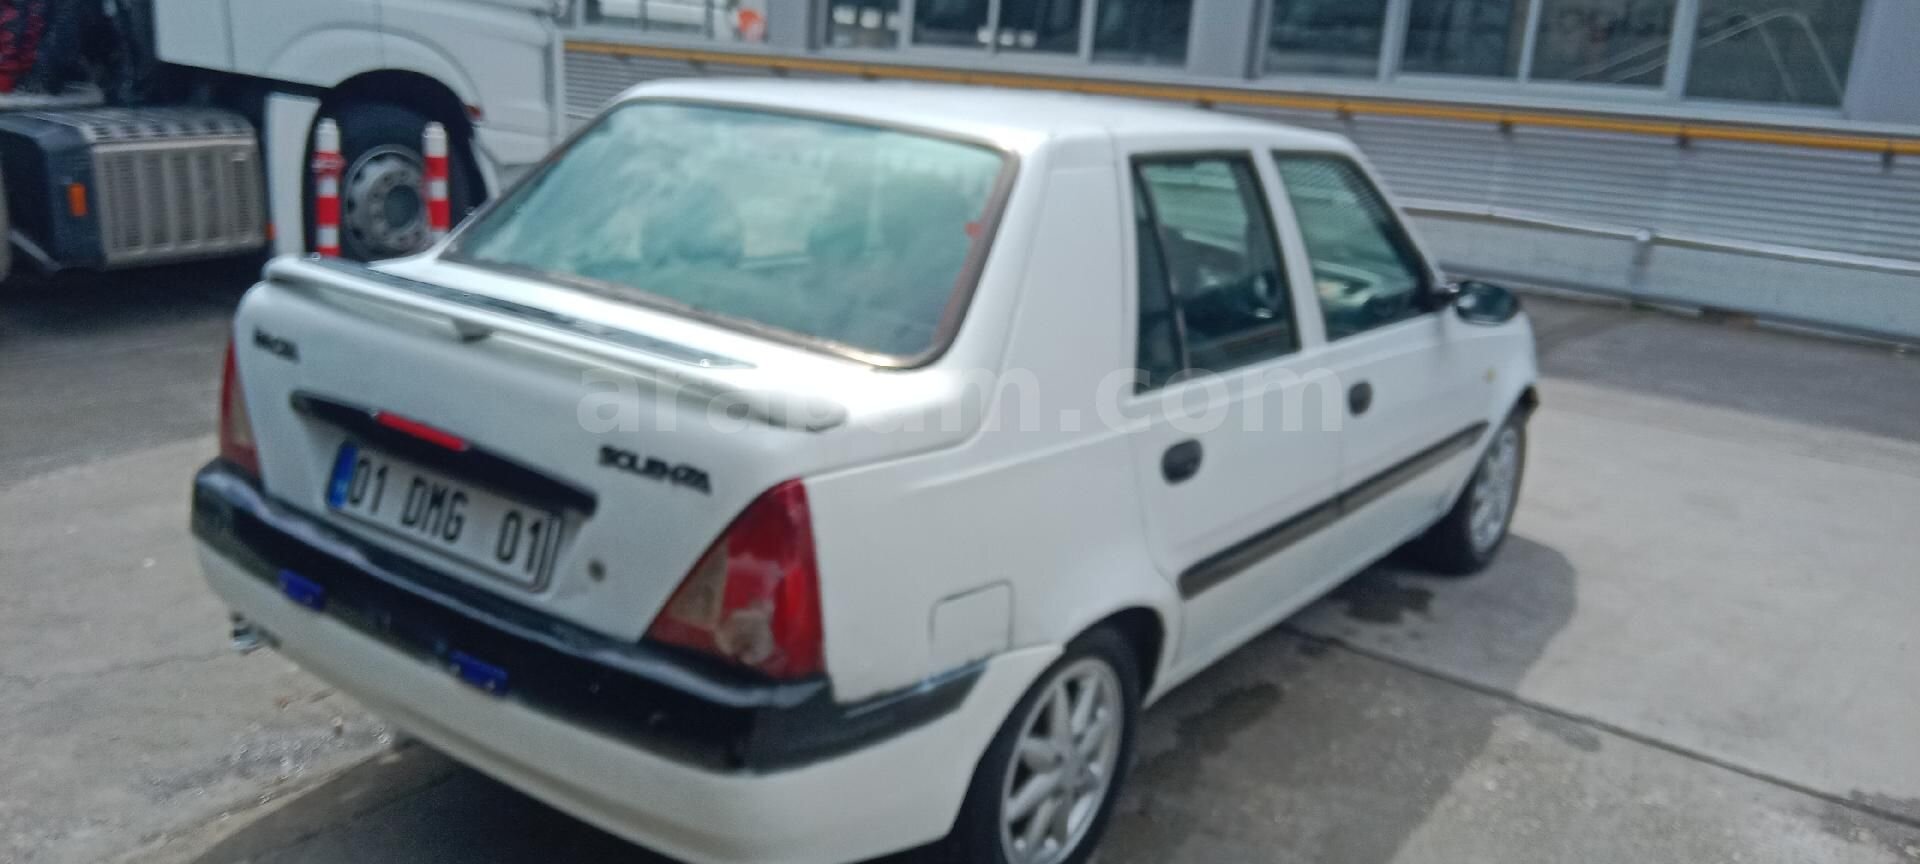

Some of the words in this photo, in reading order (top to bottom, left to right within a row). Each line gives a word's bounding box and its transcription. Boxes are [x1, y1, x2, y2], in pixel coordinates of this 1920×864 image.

[350, 457, 388, 513] 01
[402, 476, 468, 542] DMG
[497, 510, 541, 574] 01
